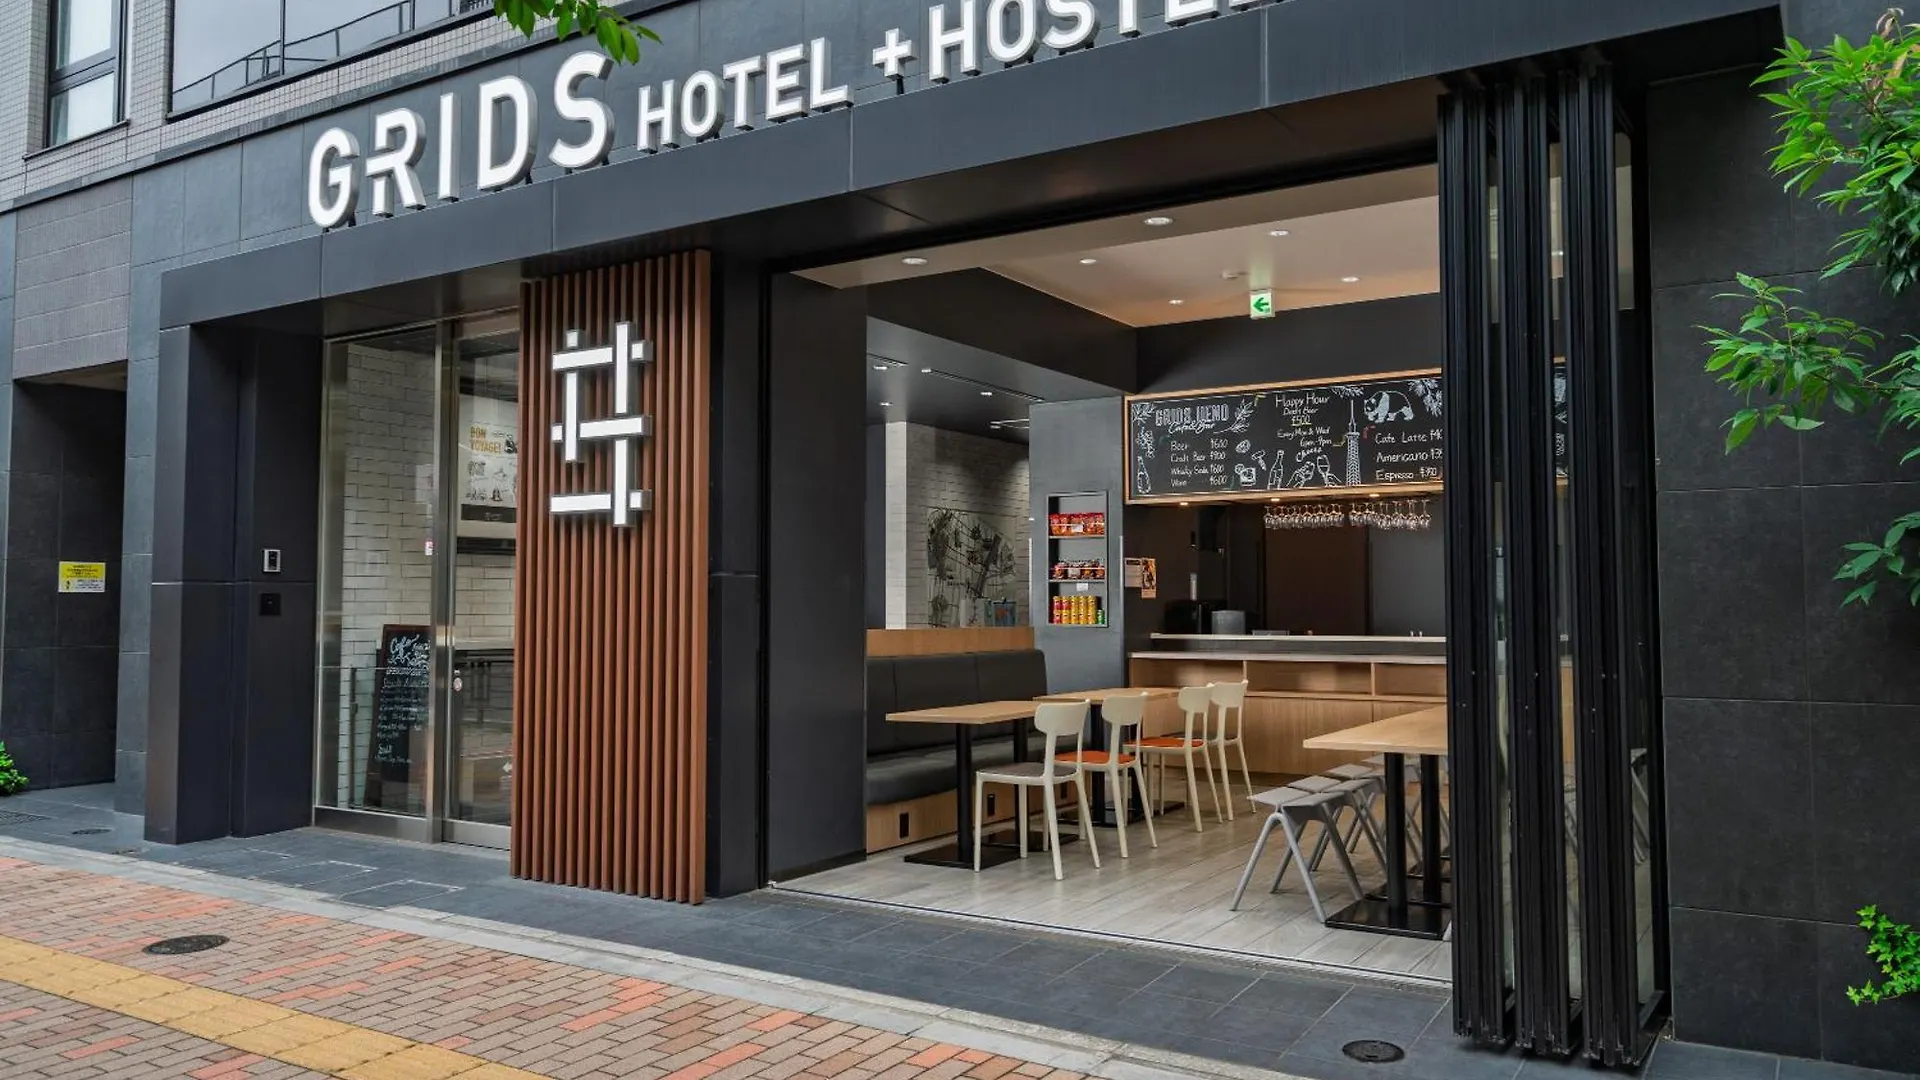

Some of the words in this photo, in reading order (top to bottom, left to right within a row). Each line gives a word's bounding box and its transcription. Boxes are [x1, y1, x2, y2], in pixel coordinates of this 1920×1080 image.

[308, 50, 615, 229] GRIDS
[636, 37, 853, 153] HOTEL
[928, 0, 1269, 84] HOS
[1275, 394, 1304, 408] Happy
[1305, 392, 1330, 405] Hour
[470, 426, 487, 439] BON
[1401, 431, 1428, 444] Latte
[1375, 450, 1429, 464] Americano
